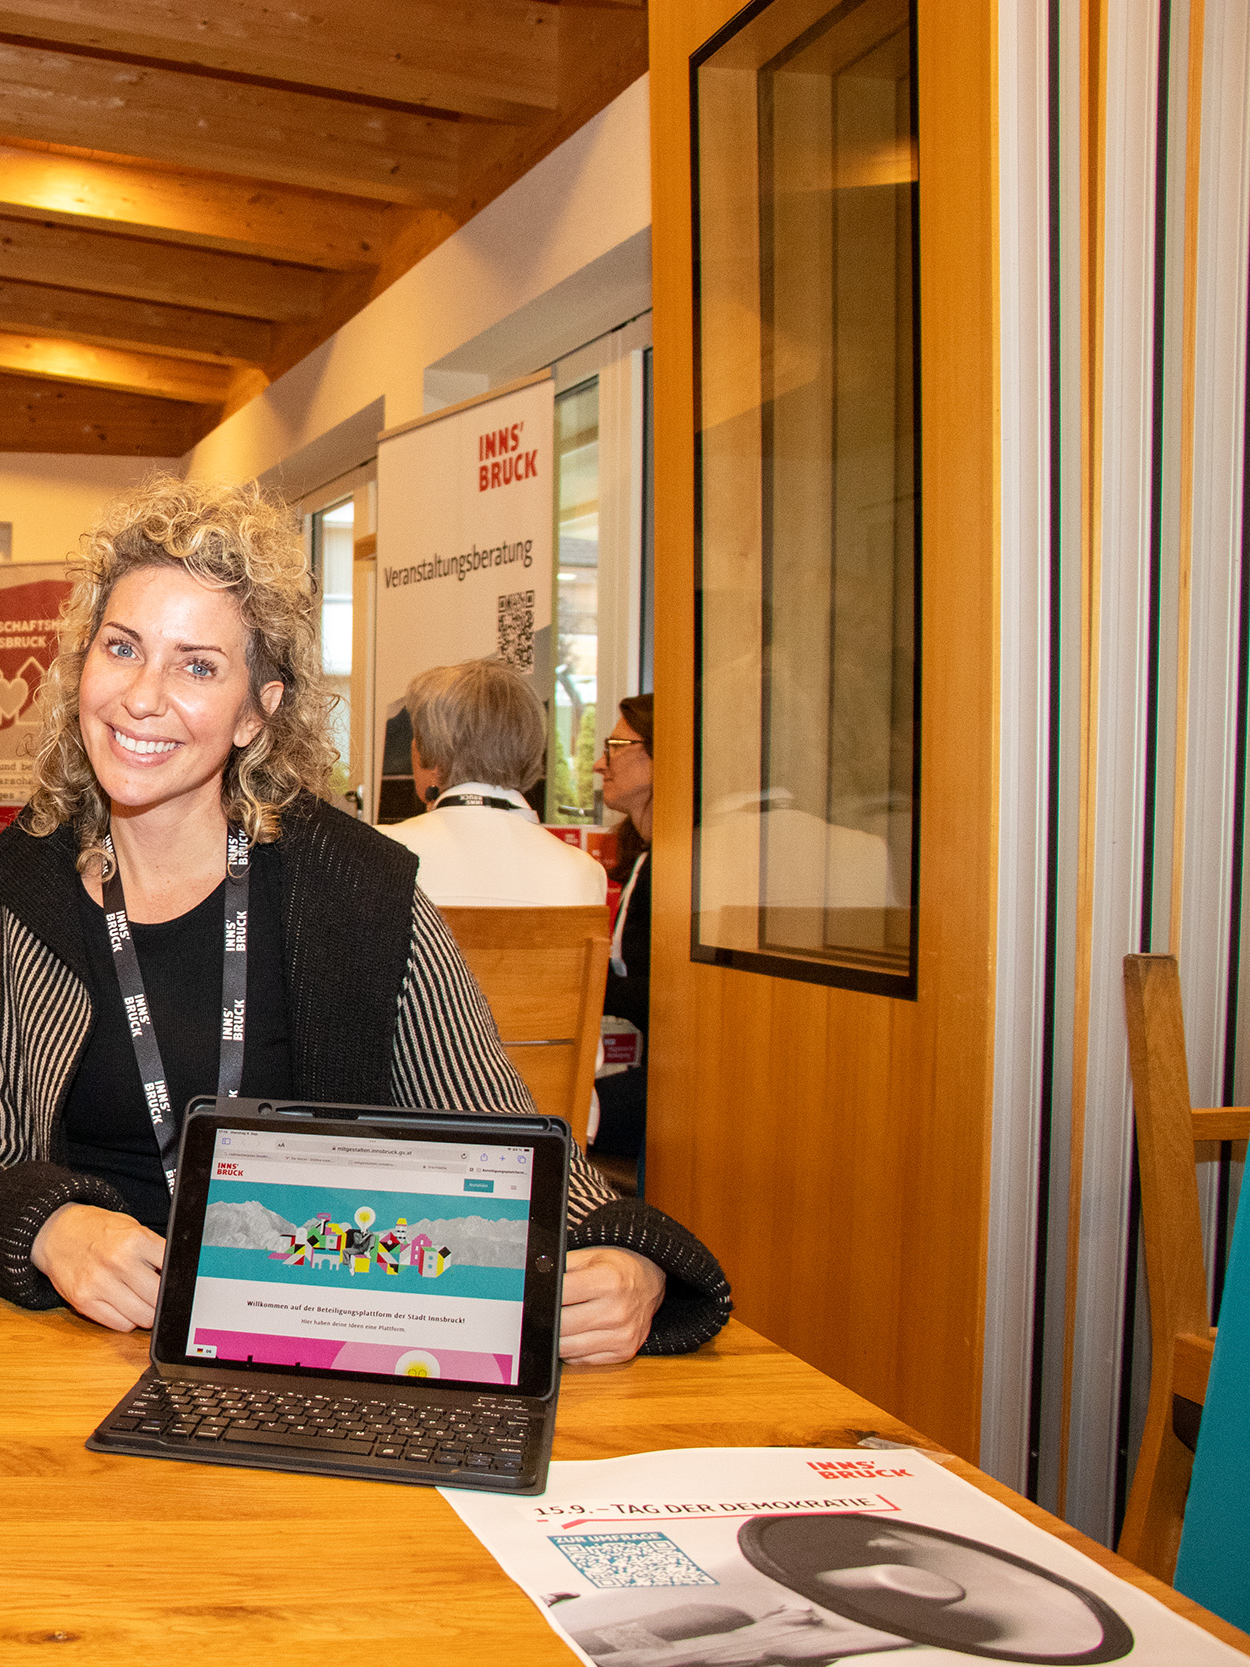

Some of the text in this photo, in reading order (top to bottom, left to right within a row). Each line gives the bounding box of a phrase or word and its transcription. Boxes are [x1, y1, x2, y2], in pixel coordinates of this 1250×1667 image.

[479, 421, 524, 462] INNS'
[479, 450, 538, 492] BRUCK
[384, 538, 533, 590] Veranstaltungsberatung
[21, 762, 33, 770] be
[228, 835, 238, 865] INNS'
[238, 830, 249, 866] BRUCK
[106, 913, 122, 953] BRUCK
[116, 910, 131, 940] INNS'
[225, 920, 236, 951] INNS'
[236, 911, 247, 951] BRUCK
[124, 996, 142, 1038] BRUCK
[134, 994, 151, 1025] INNS'
[222, 1008, 234, 1040] INNS'
[233, 1000, 245, 1041] BRUCK
[144, 1082, 163, 1125] BRUCK
[154, 1080, 171, 1112] INNS'
[247, 1300, 288, 1310] Willkommen
[317, 1306, 392, 1319] Beteiligungsplattform
[428, 1315, 465, 1324] Innsbruck!
[806, 1460, 876, 1471] INNS'
[817, 1469, 914, 1479] BRUCK
[664, 1503, 716, 1513] DER
[719, 1498, 876, 1512] DEMOKRATIE
[554, 1532, 662, 1544] ZUR UMFRAGE
